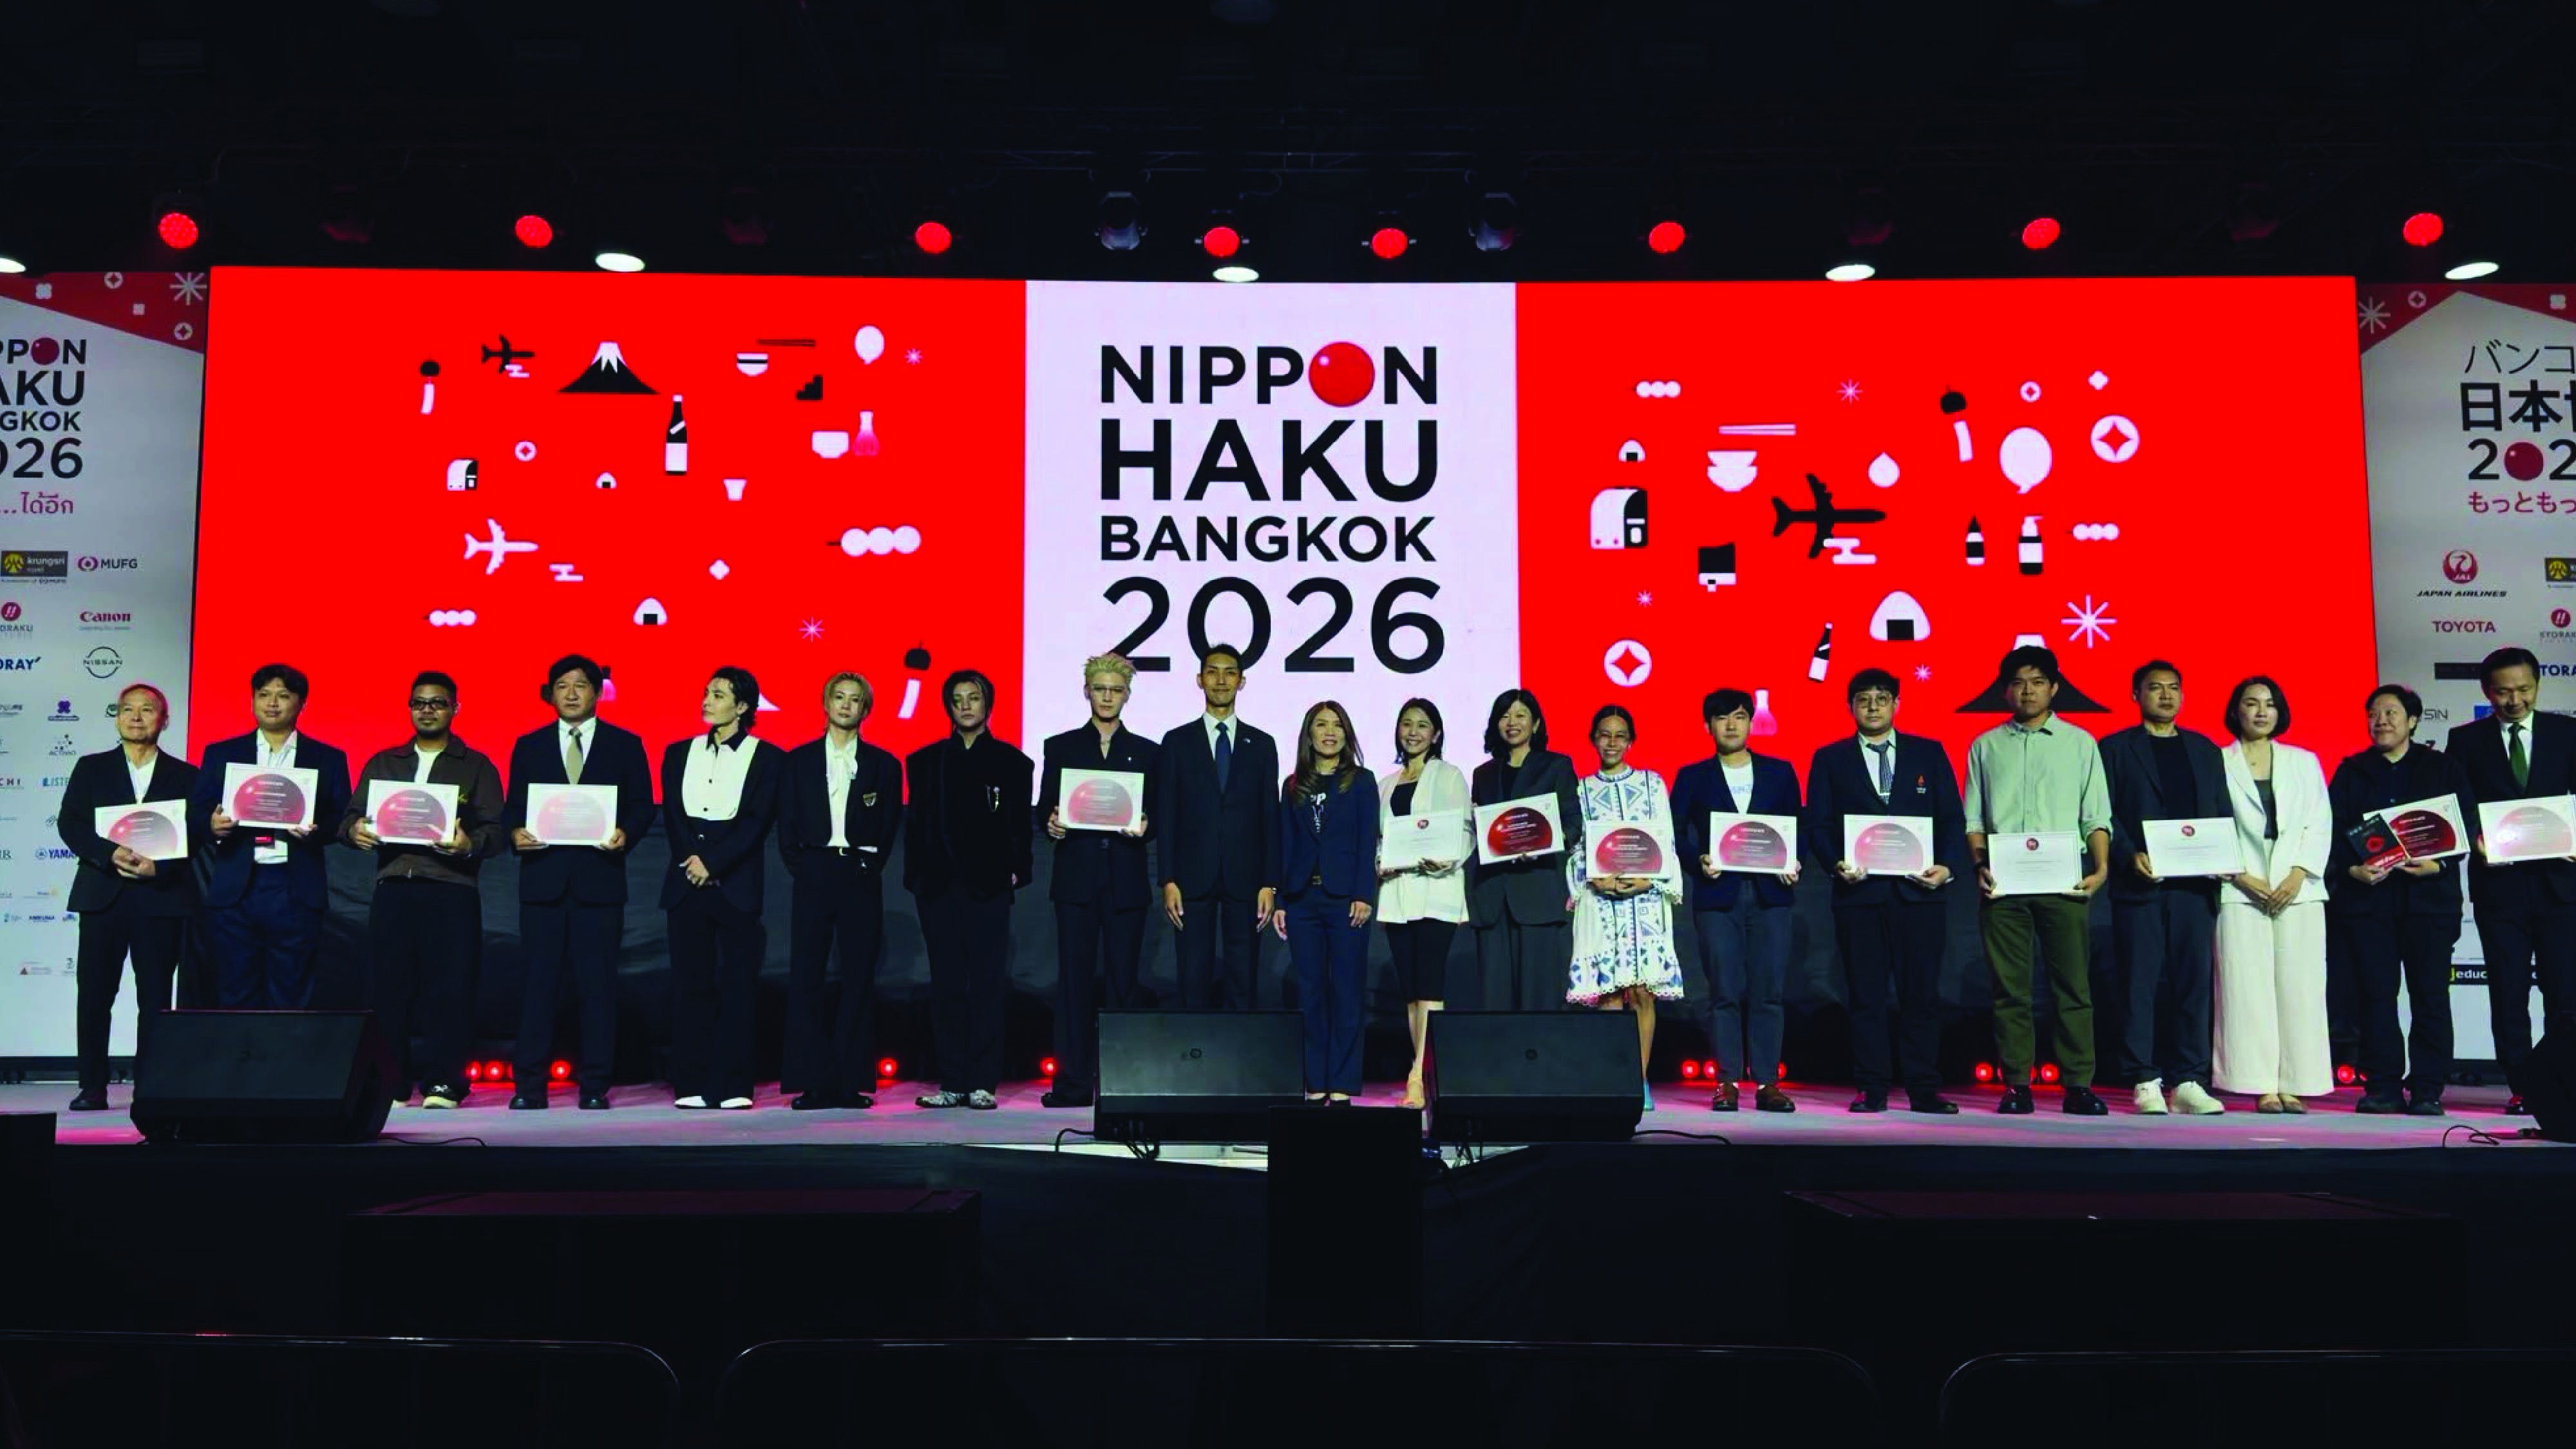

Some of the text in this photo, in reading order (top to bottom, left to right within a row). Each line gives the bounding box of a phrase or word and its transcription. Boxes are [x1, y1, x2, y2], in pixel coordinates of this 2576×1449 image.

[0, 337, 86, 365] PON
[2465, 339, 2575, 374] バンコ
[1101, 341, 1437, 407] NIPPON
[2460, 379, 2576, 432] 日本
[0, 438, 83, 478] 26
[1101, 419, 1437, 502] HAKU
[2468, 491, 2576, 513] もっともっ
[1101, 516, 1436, 562] BANGKOK
[100, 558, 138, 569] MUFG
[80, 611, 131, 622] Canon
[1103, 576, 1444, 674] 2026
[2432, 621, 2496, 632] TOYOTA
